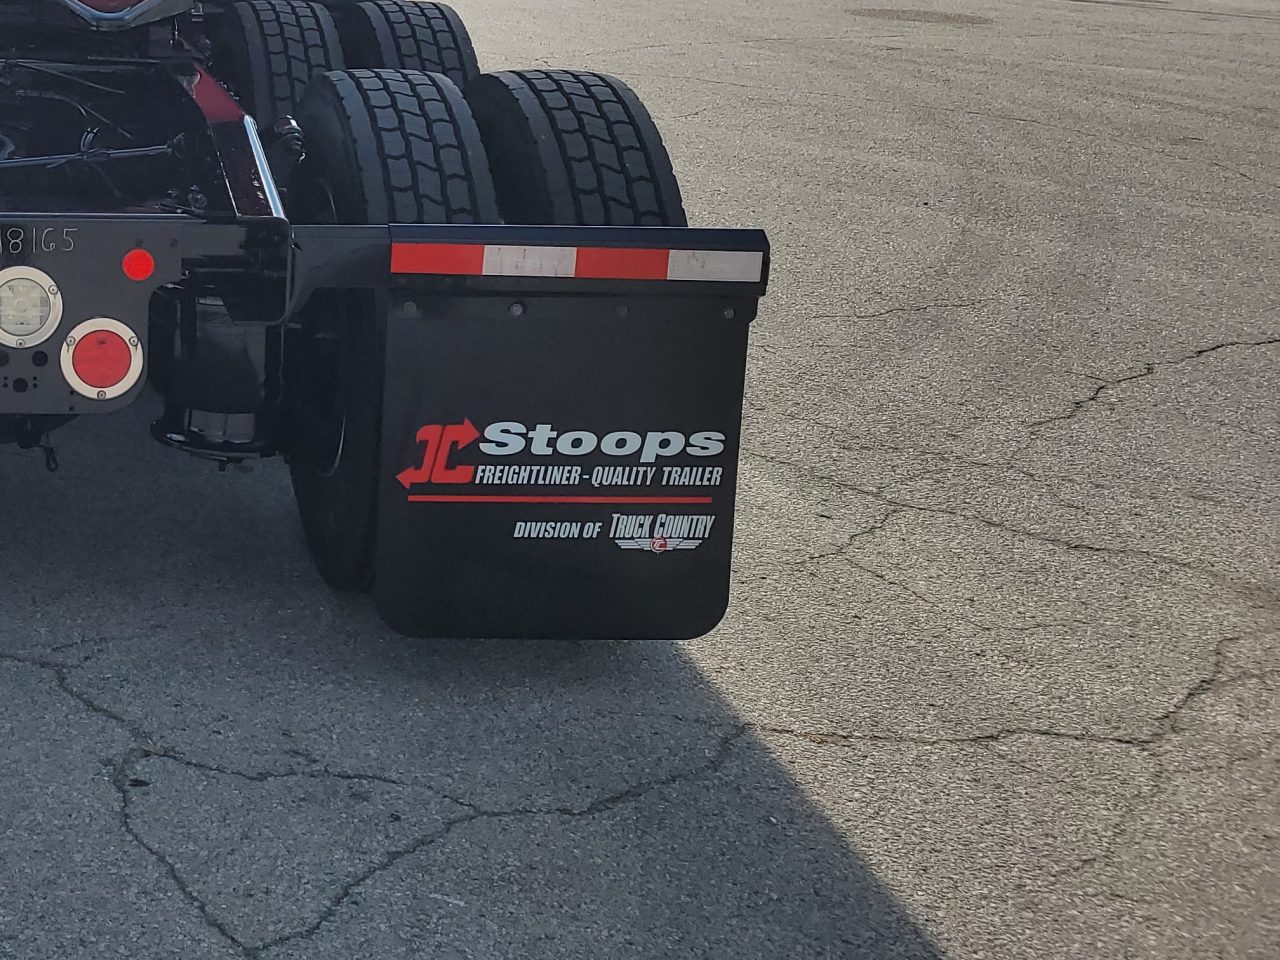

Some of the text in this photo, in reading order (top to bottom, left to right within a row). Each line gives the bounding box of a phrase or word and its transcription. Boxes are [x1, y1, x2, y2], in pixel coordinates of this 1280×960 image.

[479, 421, 726, 463] Stoops
[662, 466, 723, 486] TRAILER
[514, 513, 715, 538] DIVISION OF TRUCK COUNTRY
